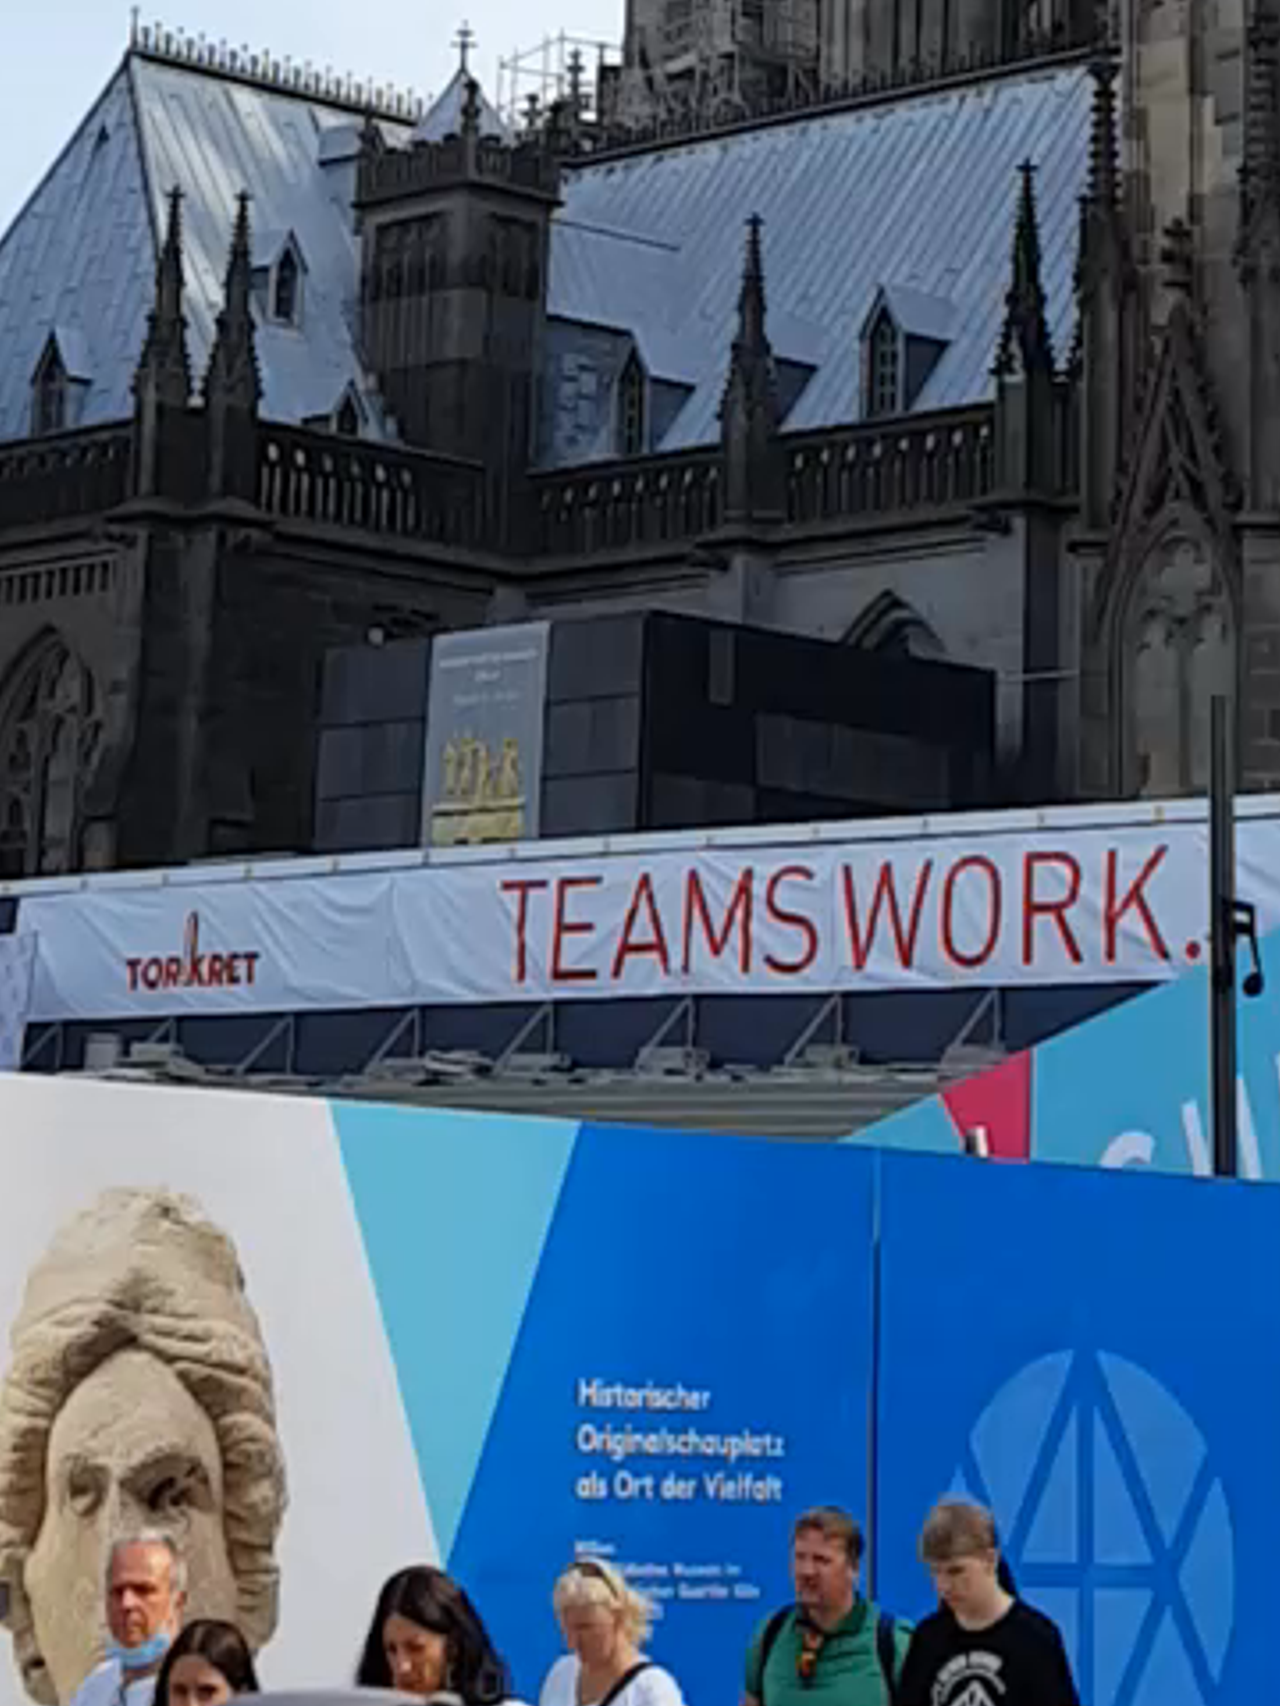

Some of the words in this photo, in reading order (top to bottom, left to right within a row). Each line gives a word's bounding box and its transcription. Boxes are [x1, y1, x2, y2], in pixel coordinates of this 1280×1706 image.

[499, 845, 1201, 984] TEAMSWORK.
[126, 911, 259, 991] TORKRET
[576, 1377, 712, 1410] Historischer
[576, 1422, 786, 1464] Originalschauplatz
[575, 1470, 608, 1500] als
[613, 1469, 654, 1500] Ort
[659, 1470, 697, 1500] der
[703, 1470, 783, 1501] Vielfalt
